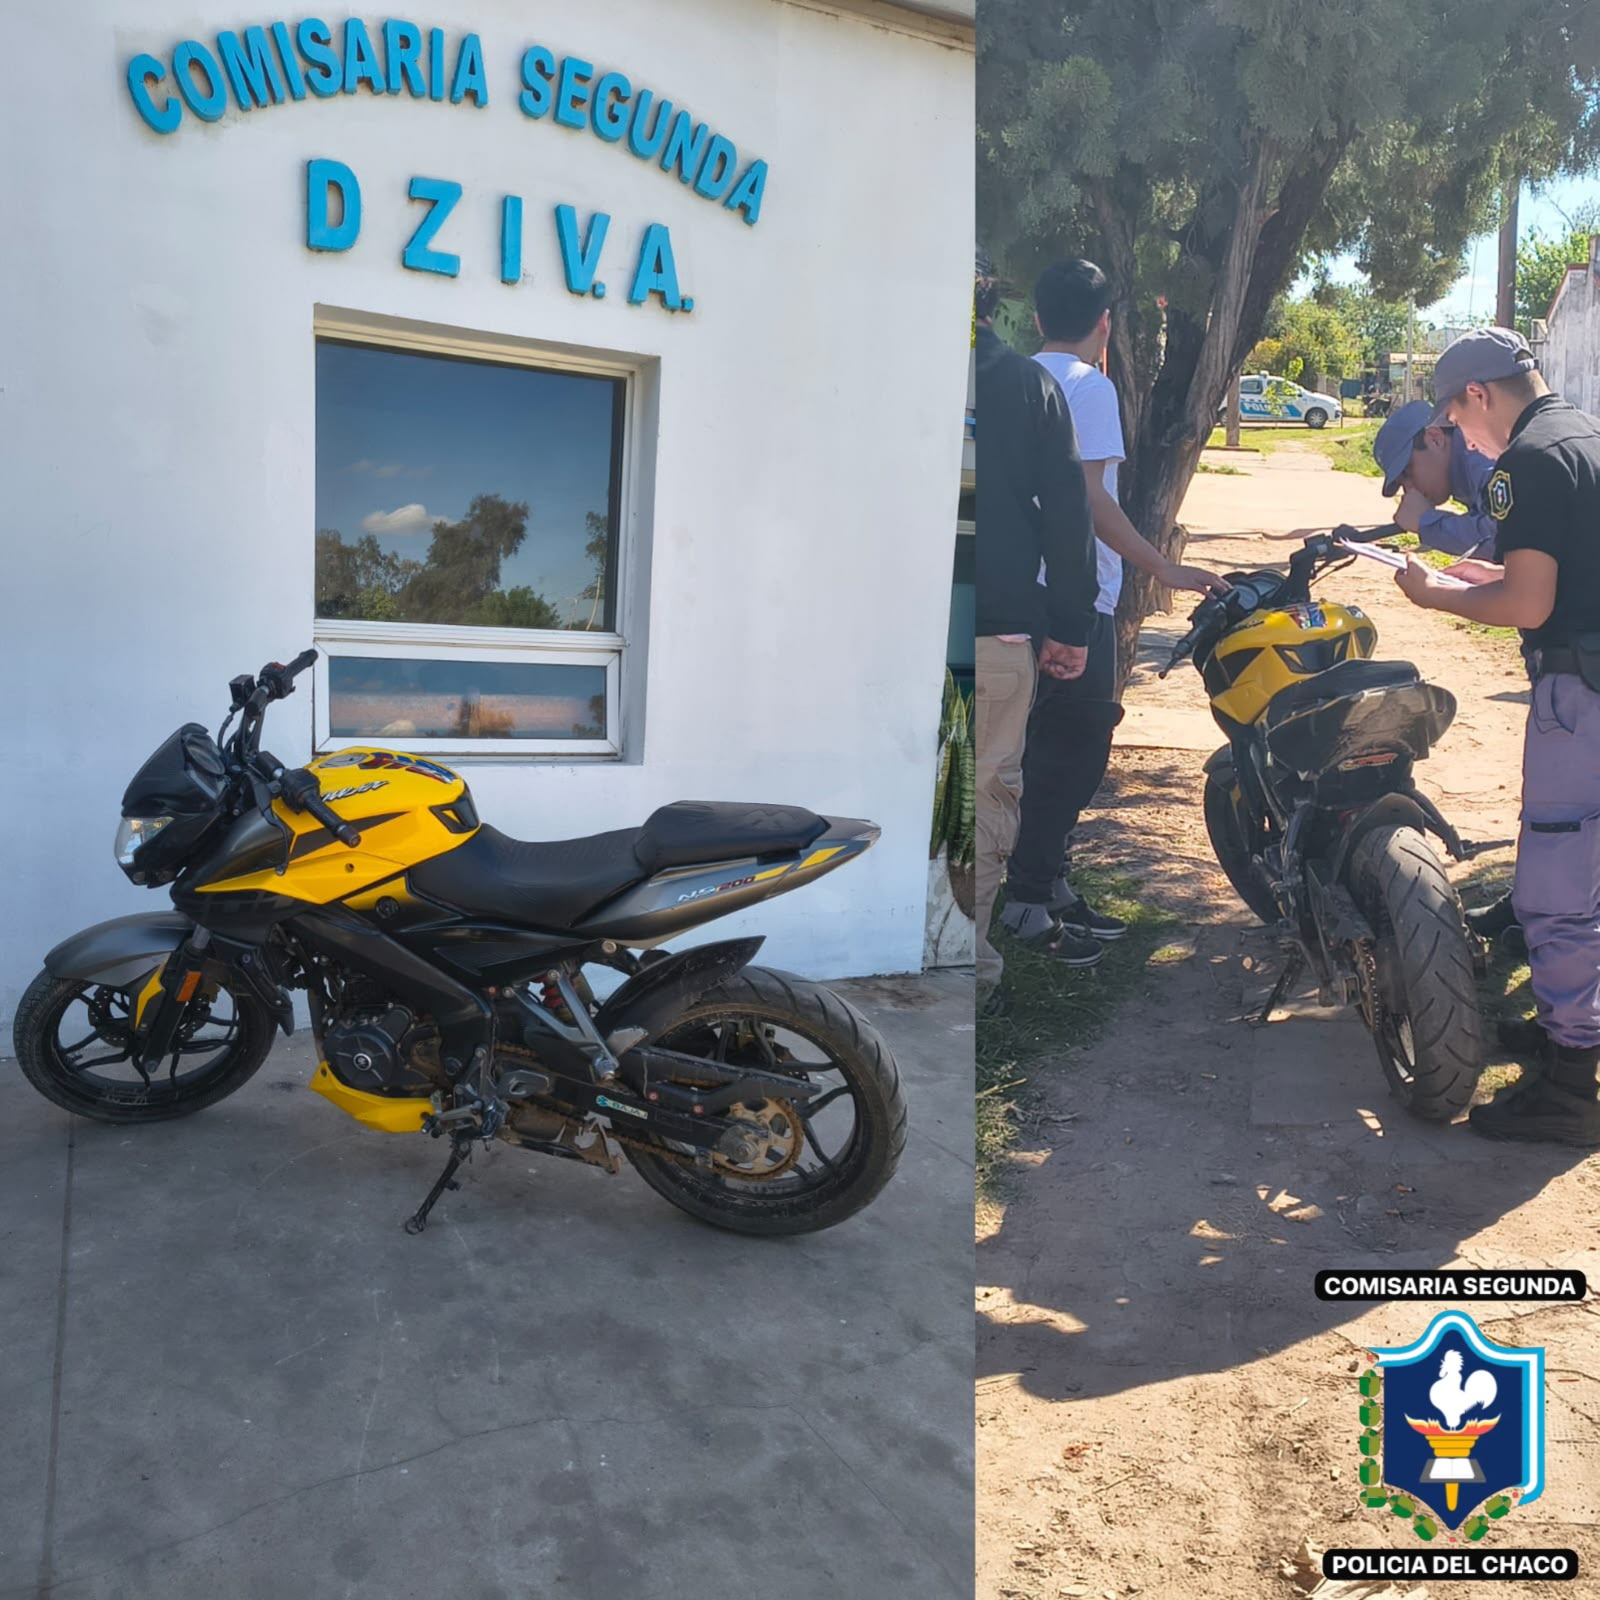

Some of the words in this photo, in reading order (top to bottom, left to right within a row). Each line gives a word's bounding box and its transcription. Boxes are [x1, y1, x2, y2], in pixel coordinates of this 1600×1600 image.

[127, 17, 489, 134] COMISARIA
[519, 45, 768, 224] SEGUNDA
[1243, 402, 1291, 415] POLIIA
